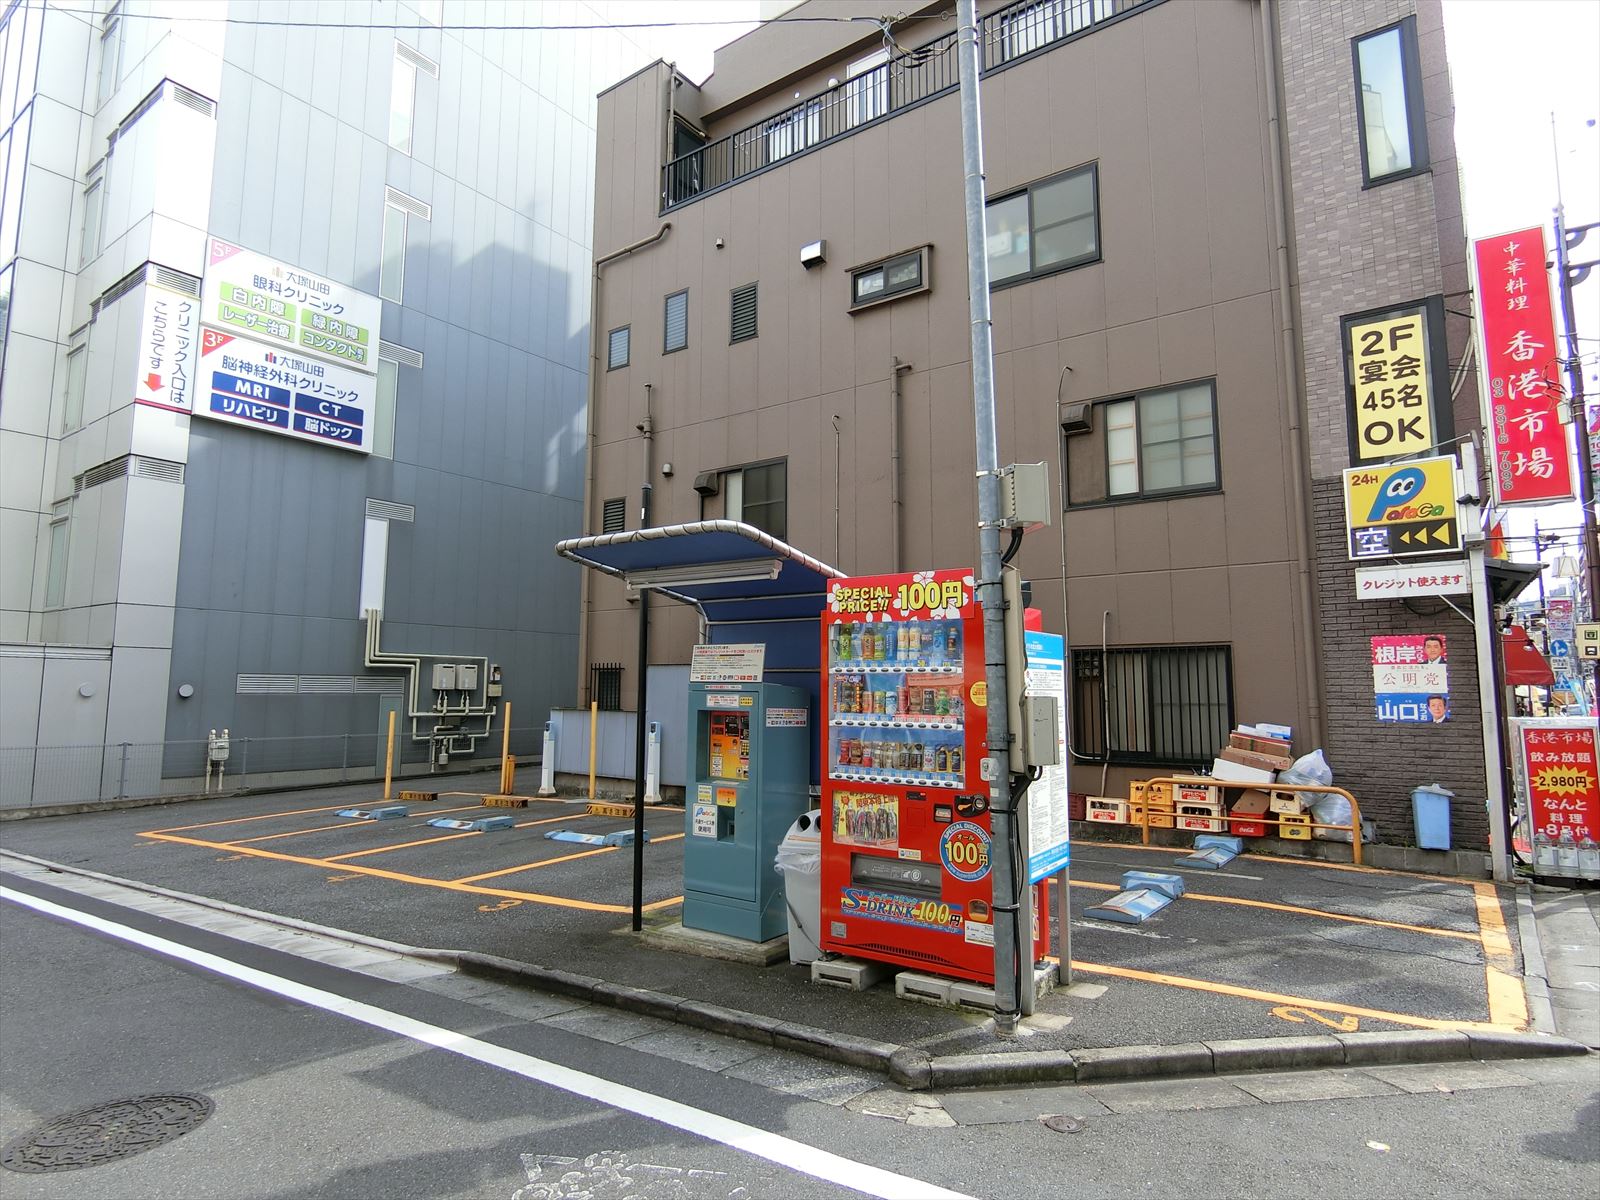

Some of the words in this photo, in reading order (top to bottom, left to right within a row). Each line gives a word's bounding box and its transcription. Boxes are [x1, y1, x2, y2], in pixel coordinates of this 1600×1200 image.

[213, 242, 232, 257] 5F
[286, 271, 331, 296] 大塚山田
[1503, 241, 1529, 311] 中華料理
[232, 287, 286, 317] 白内障
[253, 274, 345, 315] 眼科クリニック
[223, 305, 291, 340] レーザー治療
[312, 312, 360, 341] 緑内障
[148, 300, 168, 369] こちらです
[203, 332, 224, 347] 3F
[1360, 323, 1415, 356] 2F
[170, 301, 192, 404] クリニック入口は
[279, 355, 325, 378] 大塚山田
[1359, 354, 1421, 385] 宴会
[222, 355, 359, 402] 脳神経外科クリニック
[235, 379, 270, 400] MRI
[1362, 384, 1422, 411] 45名
[1503, 330, 1554, 479] 香港市場
[223, 399, 278, 422] リハビリ
[318, 402, 342, 417] CT
[304, 417, 353, 439] 脳ドック
[1364, 416, 1425, 446] OK
[1491, 377, 1505, 398] 03
[1499, 451, 1514, 491] 7096
[1351, 474, 1379, 487] 24H
[1355, 527, 1389, 556] 空
[1362, 574, 1464, 591] クレジット使えます
[836, 585, 893, 602] SPECIAL
[898, 581, 964, 611] 100円
[839, 599, 889, 614] PRICE!!
[1375, 645, 1417, 664] 根岸
[1383, 672, 1440, 686] 公明党
[1378, 702, 1419, 720] 山口
[1526, 731, 1593, 745] 香港市場
[1530, 752, 1591, 763] 飲み放題
[1538, 775, 1587, 788] 2,980円
[1543, 799, 1588, 811] なんと
[1550, 812, 1584, 824] 料理
[943, 823, 964, 839] SPECIAL
[1271, 1003, 1361, 1033] 2
